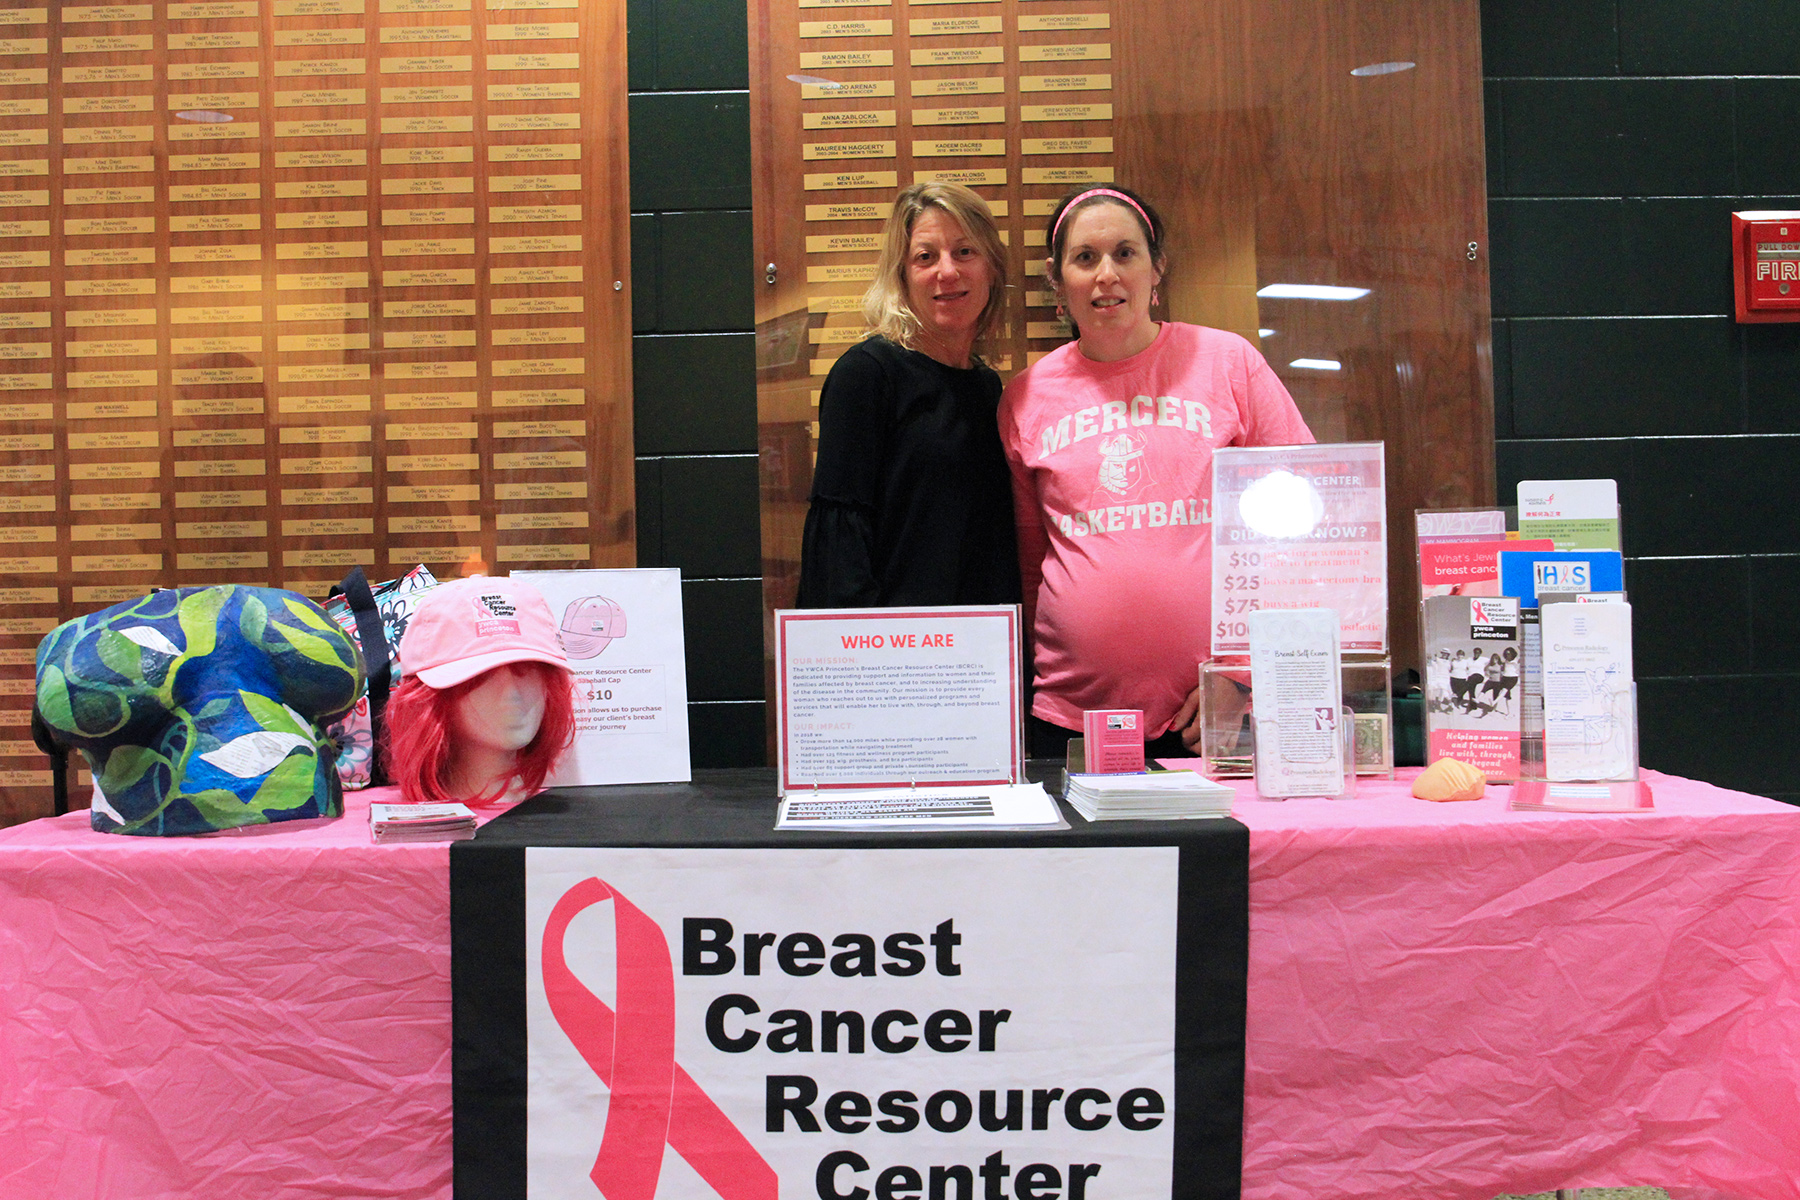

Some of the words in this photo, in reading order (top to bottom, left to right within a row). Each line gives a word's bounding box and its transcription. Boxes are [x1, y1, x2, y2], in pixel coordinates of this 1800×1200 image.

[1757, 262, 1800, 280] FIR
[1038, 395, 1213, 460] MERCER
[1314, 476, 1360, 485] CENTER
[1231, 530, 1256, 540] DID
[1229, 551, 1260, 568] $10
[1434, 554, 1470, 563] What's
[1473, 552, 1497, 561] Jewi
[1435, 566, 1468, 575] breast
[1224, 574, 1260, 592] $25
[1363, 575, 1381, 584] bra
[1225, 598, 1259, 615] $75
[841, 635, 884, 649] WHO
[890, 635, 916, 648] WE
[921, 634, 954, 647] ARE
[1297, 649, 1308, 658] Self
[587, 690, 612, 702] $10
[1446, 733, 1479, 741] Helping
[1480, 752, 1515, 760] through,
[682, 917, 962, 977] Breast
[705, 993, 1011, 1054] Cancer
[766, 1074, 1166, 1134] Resource
[816, 1150, 1100, 1200] Center
